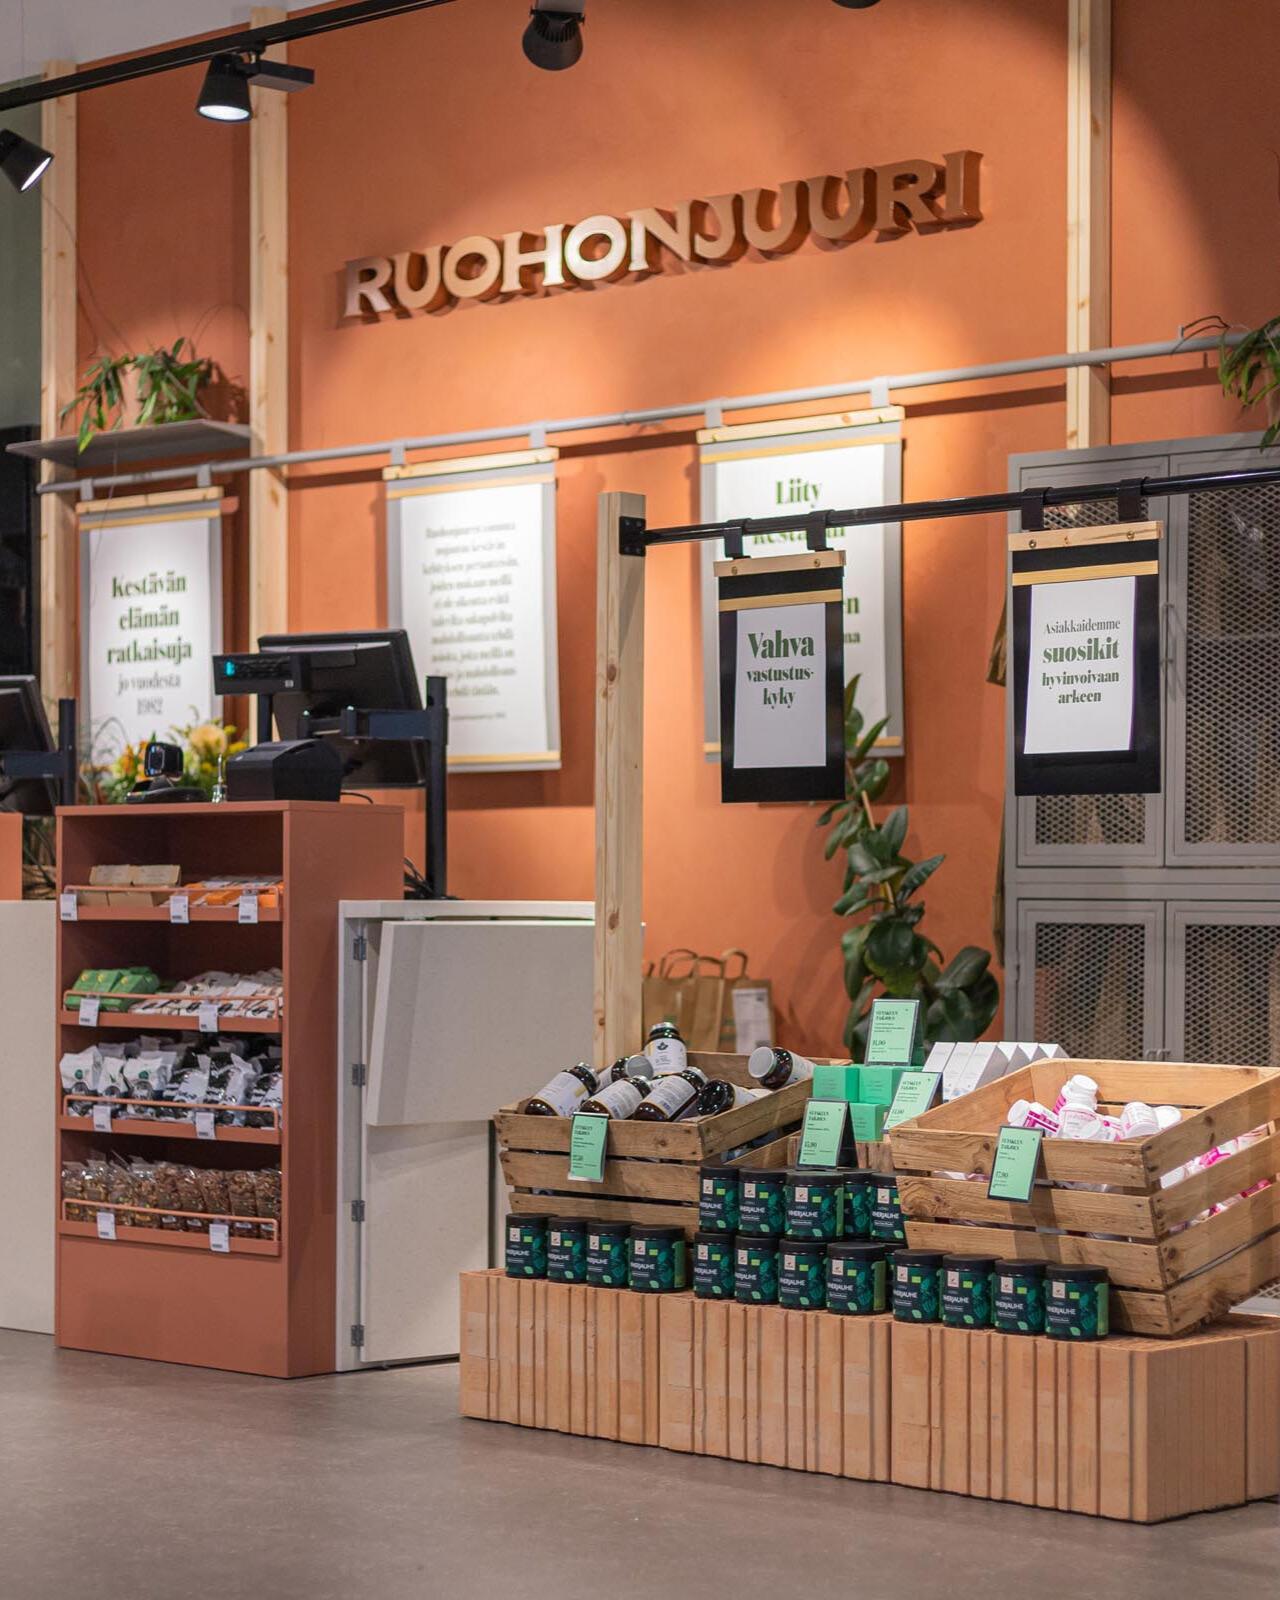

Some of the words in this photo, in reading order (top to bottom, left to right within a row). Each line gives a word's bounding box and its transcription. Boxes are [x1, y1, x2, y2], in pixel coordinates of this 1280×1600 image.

[343, 149, 983, 319] RUOHONJUURI
[776, 478, 821, 508] Liity
[119, 604, 180, 630] elämän
[1043, 618, 1120, 635] Asiakkaidemme
[107, 636, 192, 666] ratkaisuja
[747, 629, 815, 659] Vahva
[1042, 636, 1119, 664] suosikit
[746, 666, 814, 683] vastustus-
[1042, 670, 1119, 690] hyvinvoivaan
[763, 686, 796, 709] kyky
[1057, 692, 1102, 705] arkeen
